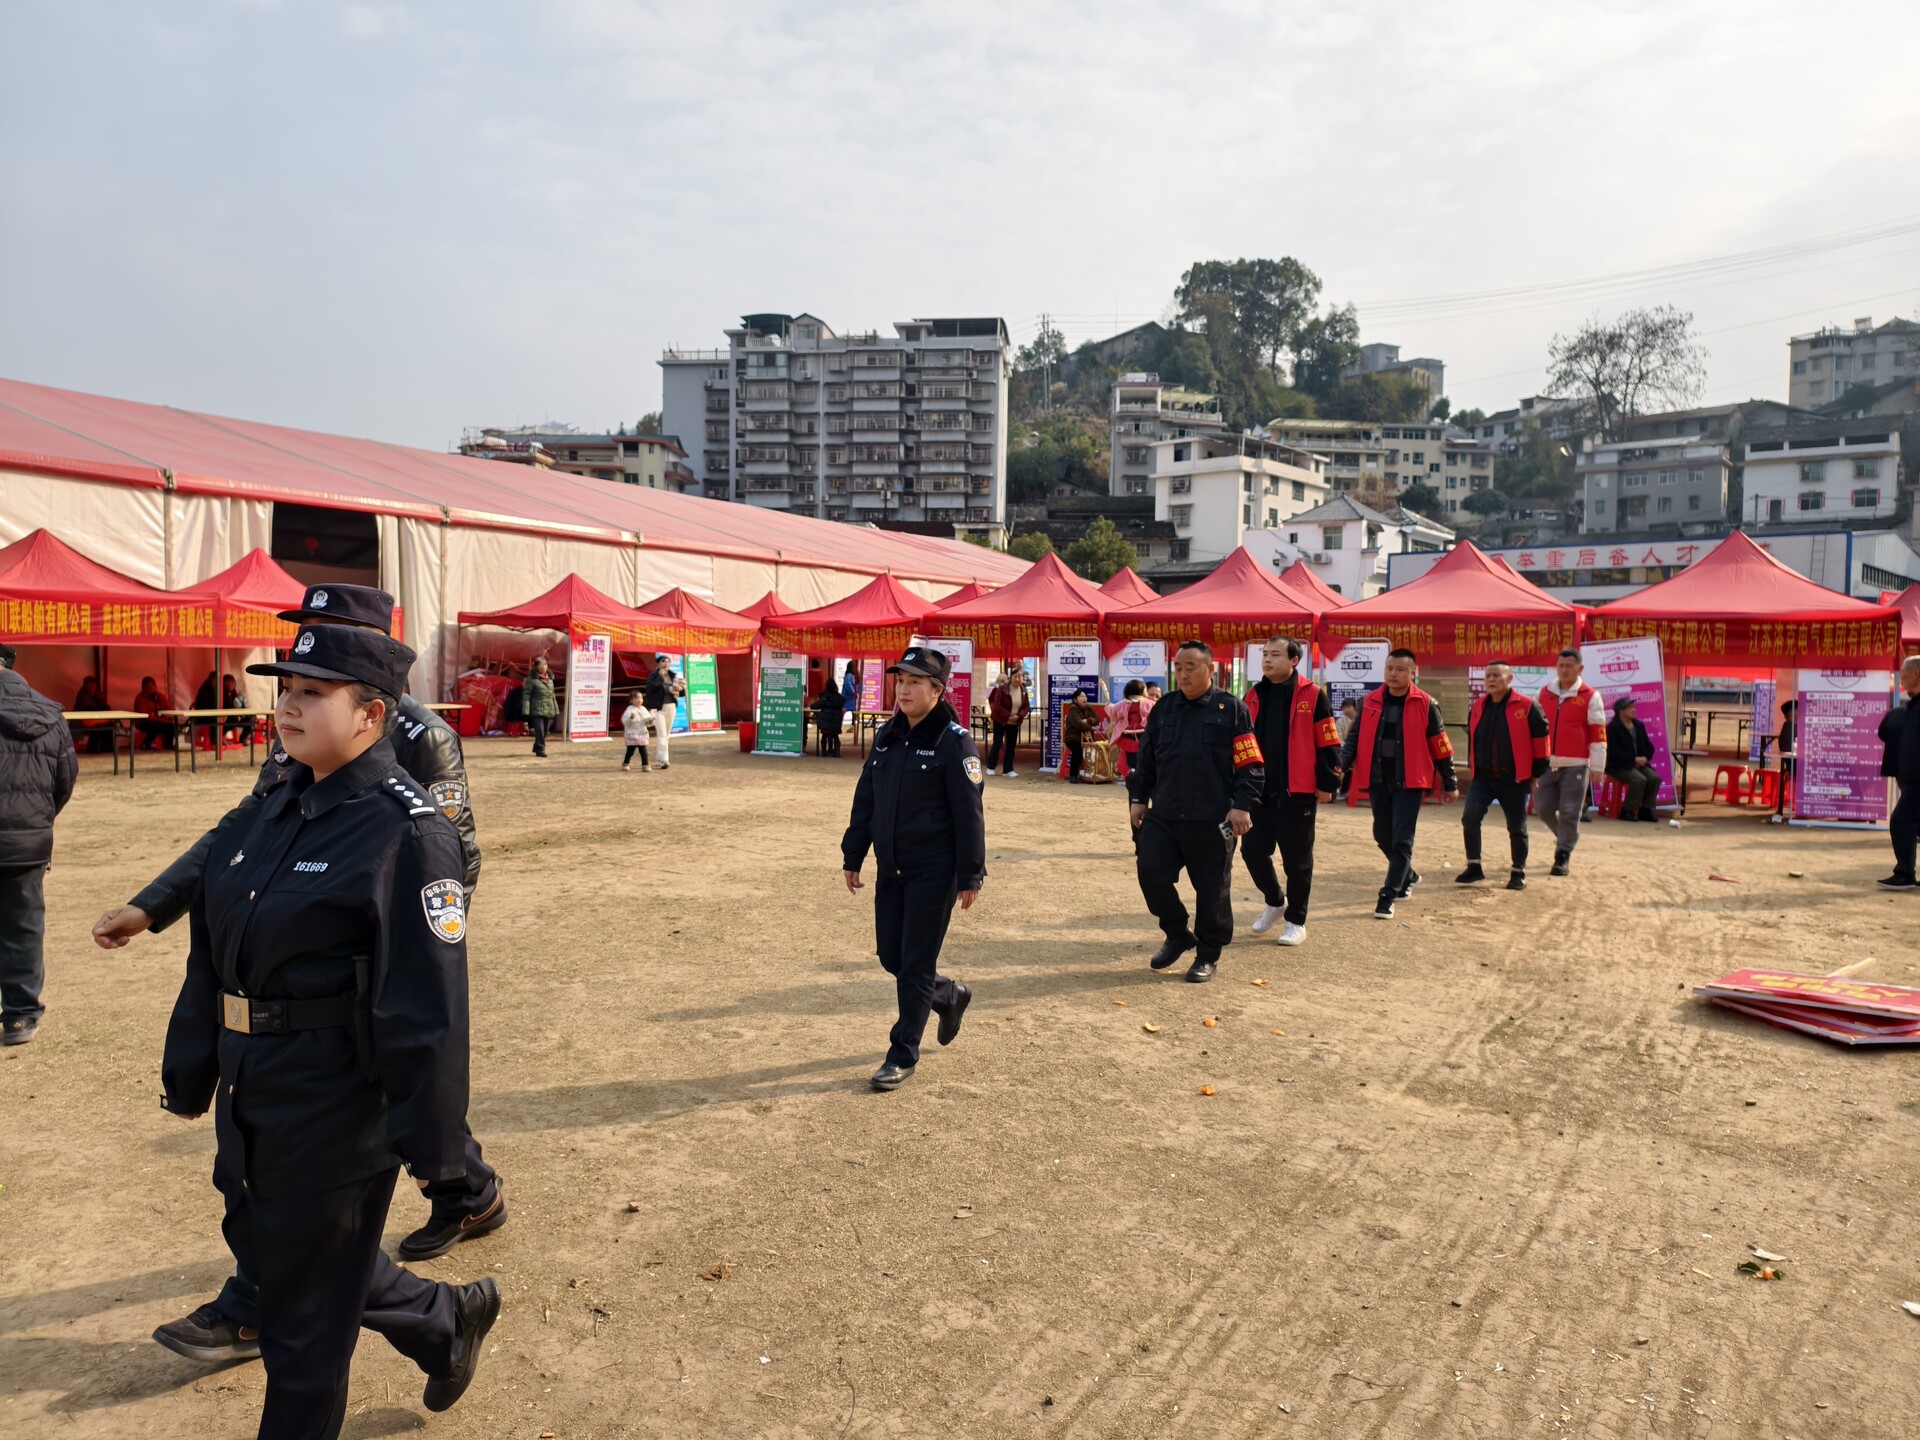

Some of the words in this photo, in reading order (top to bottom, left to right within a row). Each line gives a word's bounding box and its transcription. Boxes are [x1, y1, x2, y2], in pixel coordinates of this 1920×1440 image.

[1455, 623, 1574, 656] 福州六和机械有限公司
[1749, 620, 1898, 658] 江苏洛克电气集团有限公司
[293, 861, 329, 873] 161669
